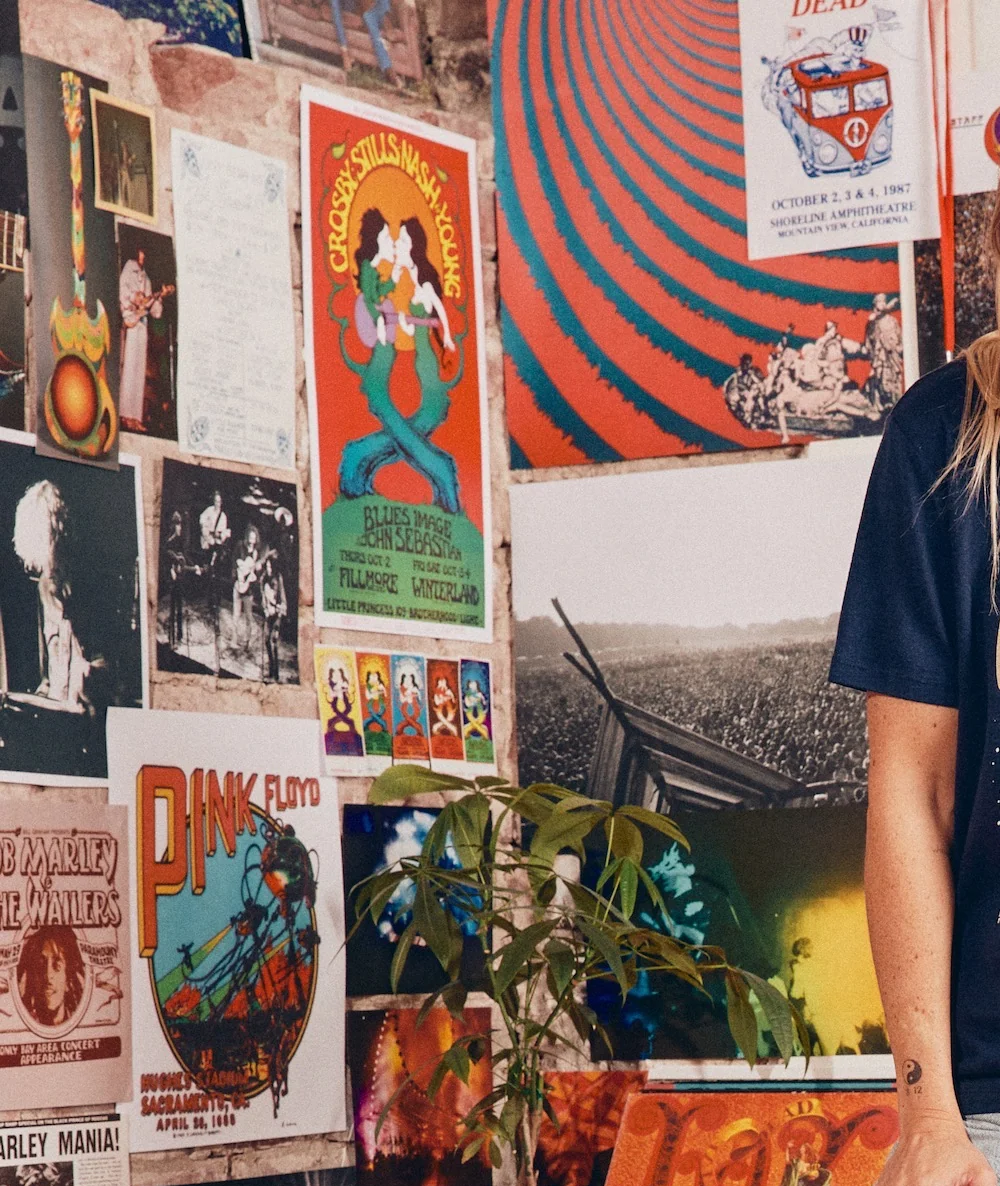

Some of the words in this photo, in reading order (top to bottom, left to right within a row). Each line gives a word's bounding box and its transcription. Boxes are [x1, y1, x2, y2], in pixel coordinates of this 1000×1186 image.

[771, 193, 828, 211] OCTOBER
[832, 192, 842, 204] 2,
[845, 190, 851, 201] 3
[855, 188, 864, 199] &
[883, 183, 911, 197] 1987
[328, 158, 360, 273] CROSBY
[350, 132, 400, 183] STILLS
[400, 139, 442, 209] NASH
[436, 202, 462, 298] YOUNG
[770, 211, 827, 228] SHORELINE
[830, 201, 916, 220] AMPHITHEATRE
[851, 215, 909, 228] CALIFORNIA
[364, 506, 411, 531] BLUES
[340, 567, 399, 594] FILLMORE
[411, 577, 480, 606] WINTERLAND
[20, 837, 119, 886] MARLEY
[136, 764, 258, 958] PINK
[265, 773, 321, 817] FLOYD
[28, 890, 121, 929] WAILERS
[20, 1050, 83, 1066] APPEARANCE
[36, 1042, 59, 1053] AREA
[60, 1039, 100, 1052] CONCERT
[156, 1118, 189, 1132] APRIL
[0, 1132, 48, 1160] ARLEY
[59, 1127, 119, 1156] MANIA!
